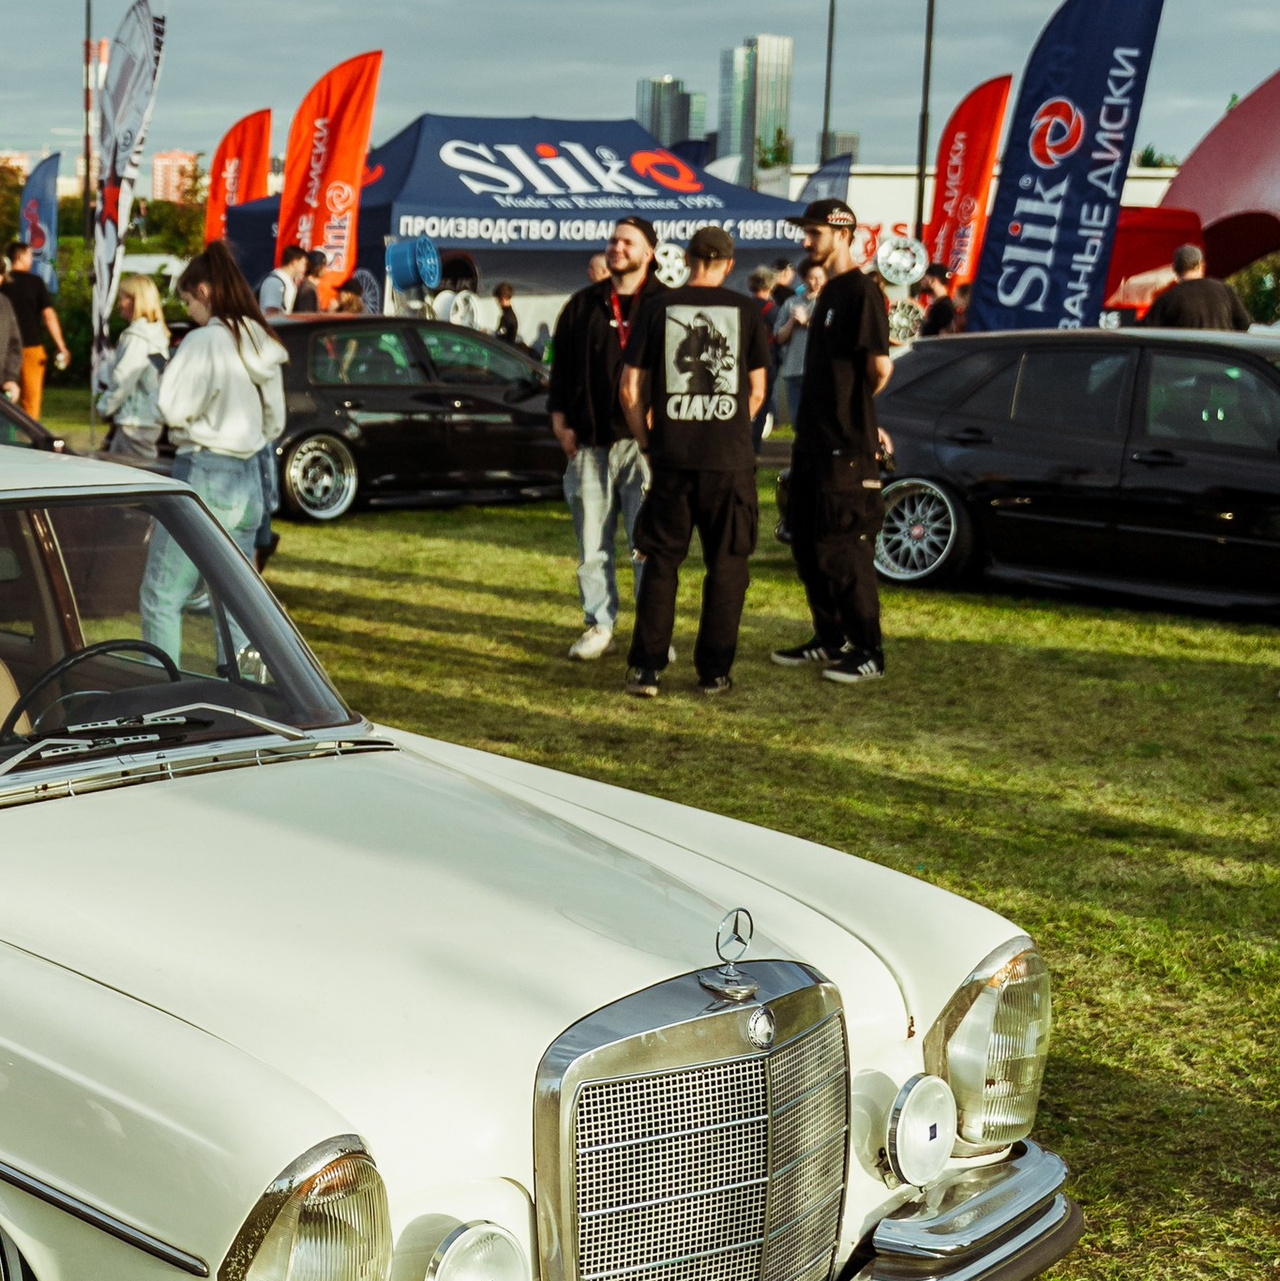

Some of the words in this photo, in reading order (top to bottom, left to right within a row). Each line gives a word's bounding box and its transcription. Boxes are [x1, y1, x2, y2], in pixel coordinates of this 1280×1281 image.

[1087, 46, 1141, 198] ДИСКИ
[942, 131, 967, 217] ДИСКИ
[400, 215, 558, 244] ПРОИЗВОДСТВО
[559, 219, 616, 241] КОВА
[737, 219, 775, 240] 1993
[775, 219, 806, 243] ГОД
